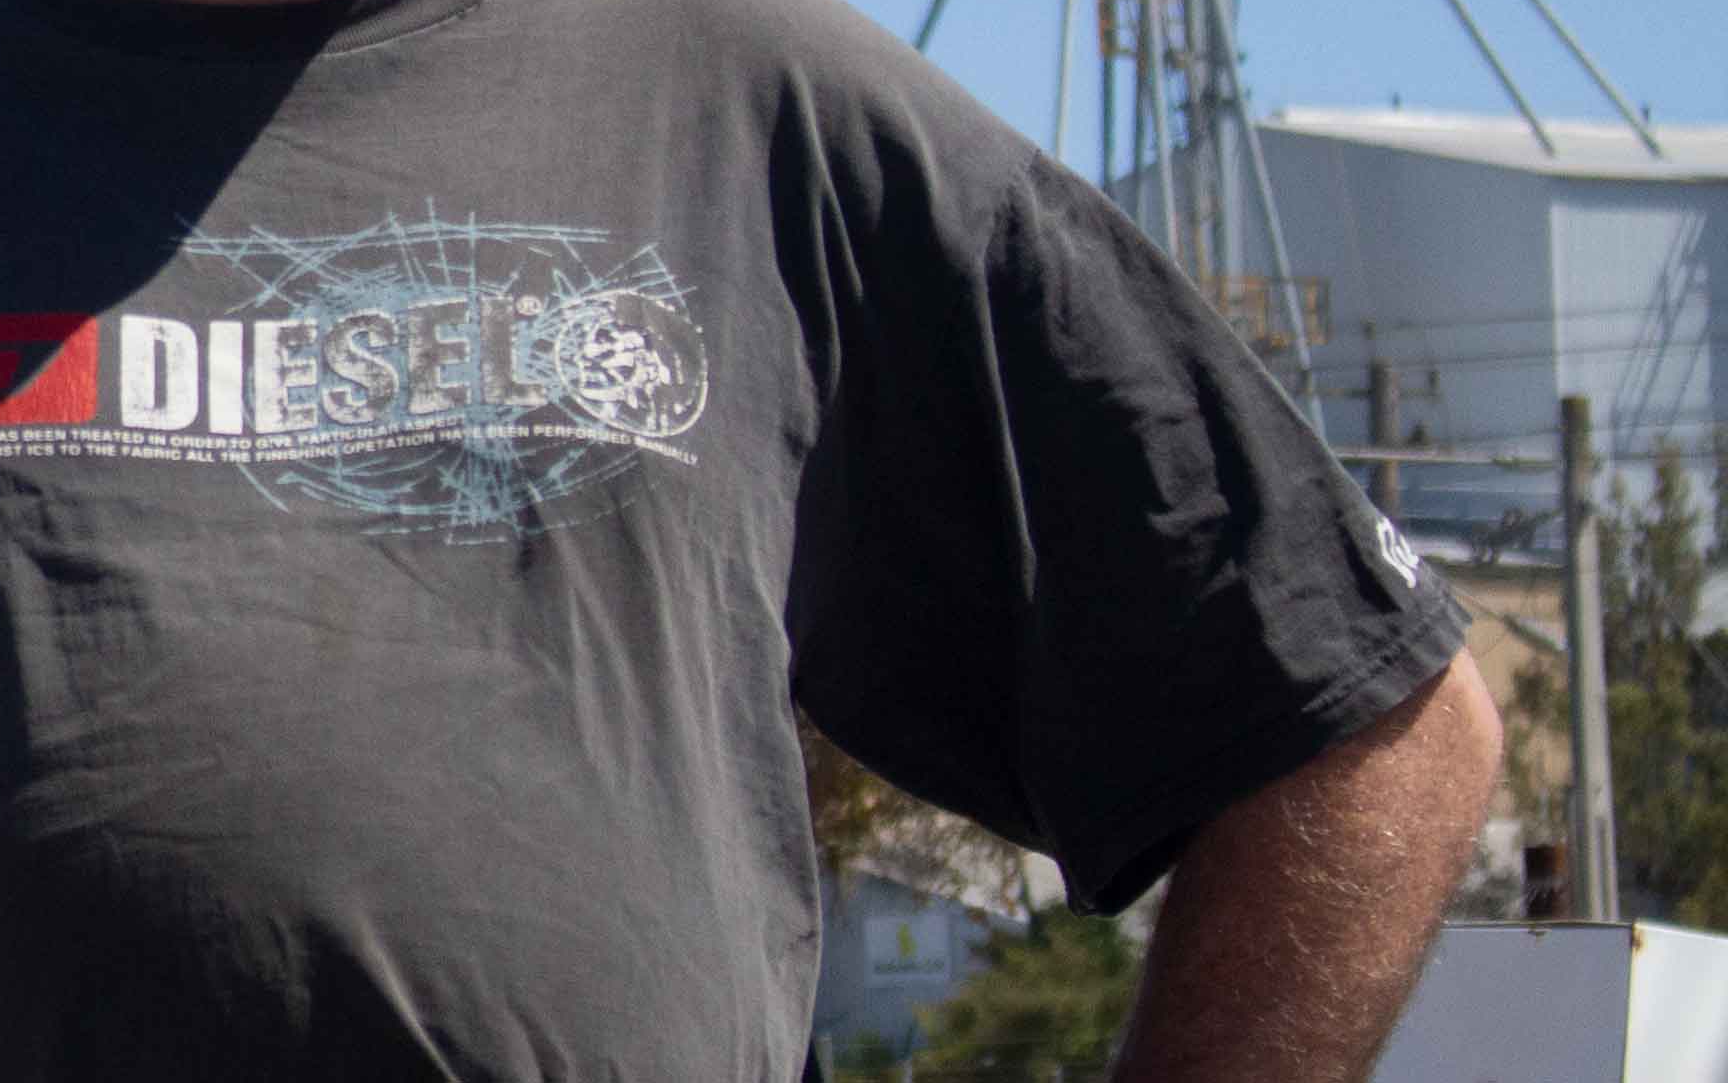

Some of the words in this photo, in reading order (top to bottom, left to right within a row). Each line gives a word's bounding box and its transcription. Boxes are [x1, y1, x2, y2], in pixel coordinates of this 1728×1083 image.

[120, 297, 548, 435] DIESEL
[22, 428, 67, 443] BEEN
[69, 429, 145, 446] TREATED
[148, 434, 167, 447] IN
[169, 434, 227, 450] ORDER
[296, 424, 399, 447] PARTICULAR
[59, 443, 82, 457] TO
[84, 443, 117, 458] THE
[120, 444, 183, 462] FABRIC
[185, 449, 216, 463] ALL
[219, 450, 252, 464] THE
[254, 445, 338, 464] FINISHING
[532, 423, 633, 445] PERFORMED
